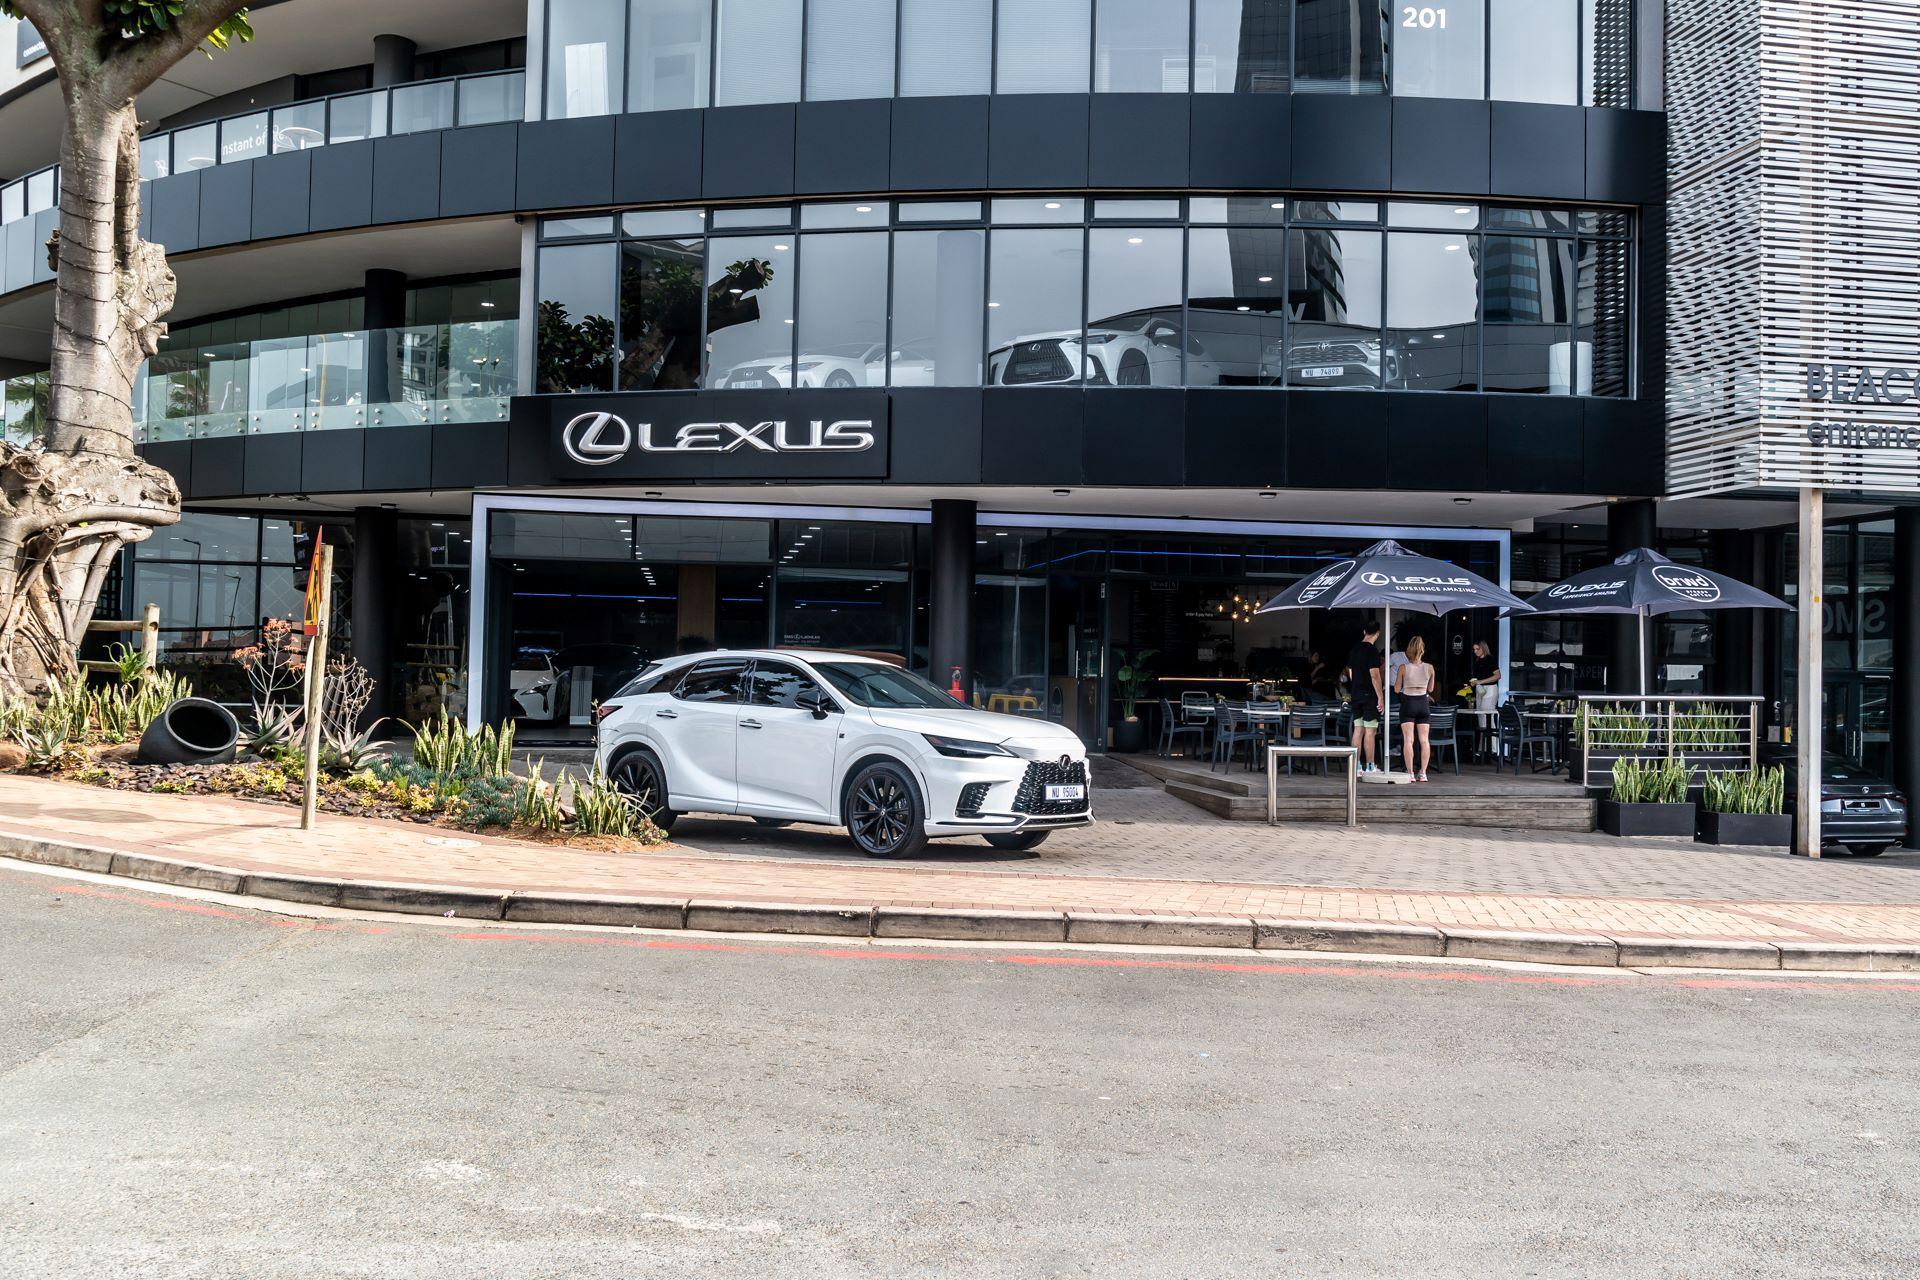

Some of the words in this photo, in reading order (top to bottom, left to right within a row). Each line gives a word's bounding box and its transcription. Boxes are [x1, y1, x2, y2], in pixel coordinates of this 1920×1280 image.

[1402, 7, 1446, 28] 201
[221, 135, 254, 155] nstant
[1807, 364, 1920, 403] BEAC
[638, 420, 874, 452] LEXUS
[1390, 575, 1472, 586] LEXUS
[1569, 580, 1627, 593] LEXUS
[1658, 574, 1709, 587] brwd
[1052, 787, 1060, 798] NU
